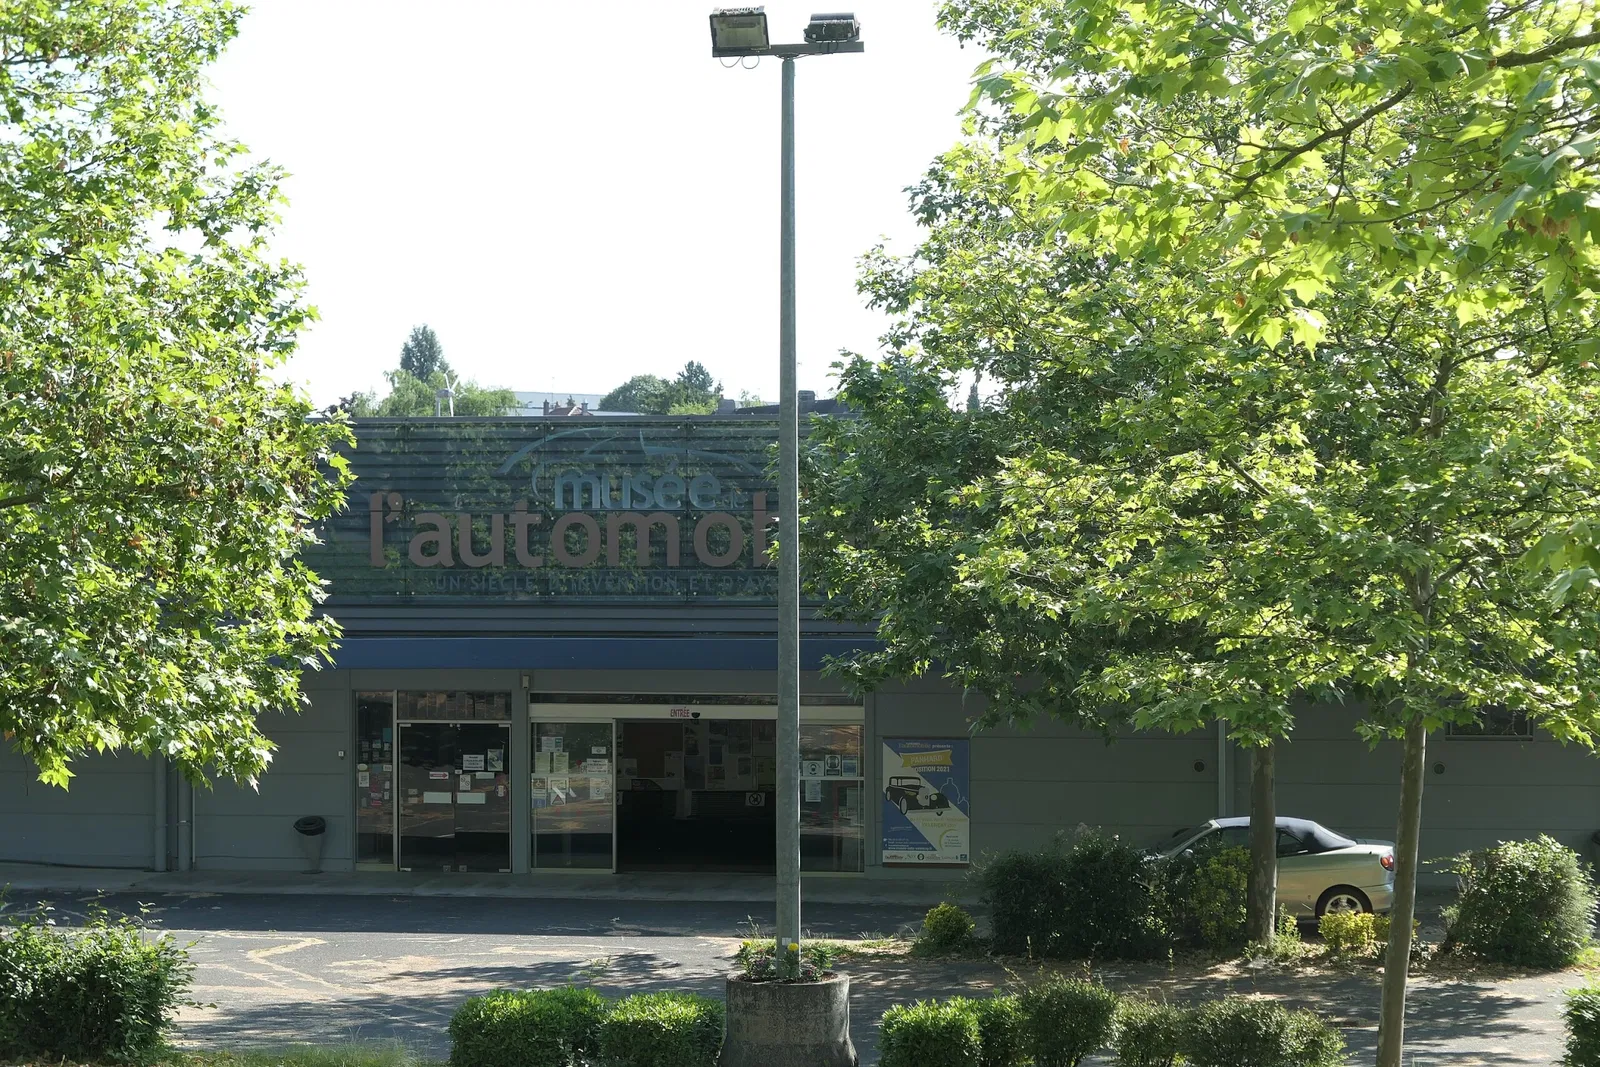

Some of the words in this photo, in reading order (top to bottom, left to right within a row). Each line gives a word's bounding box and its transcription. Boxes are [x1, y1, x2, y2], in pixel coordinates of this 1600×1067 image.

[553, 462, 722, 510] musée
[368, 489, 780, 568] l'automob
[435, 575, 461, 592] UN
[548, 575, 678, 592] DINVENTION
[689, 575, 713, 592] ET
[670, 706, 690, 718] ENTRÉE
